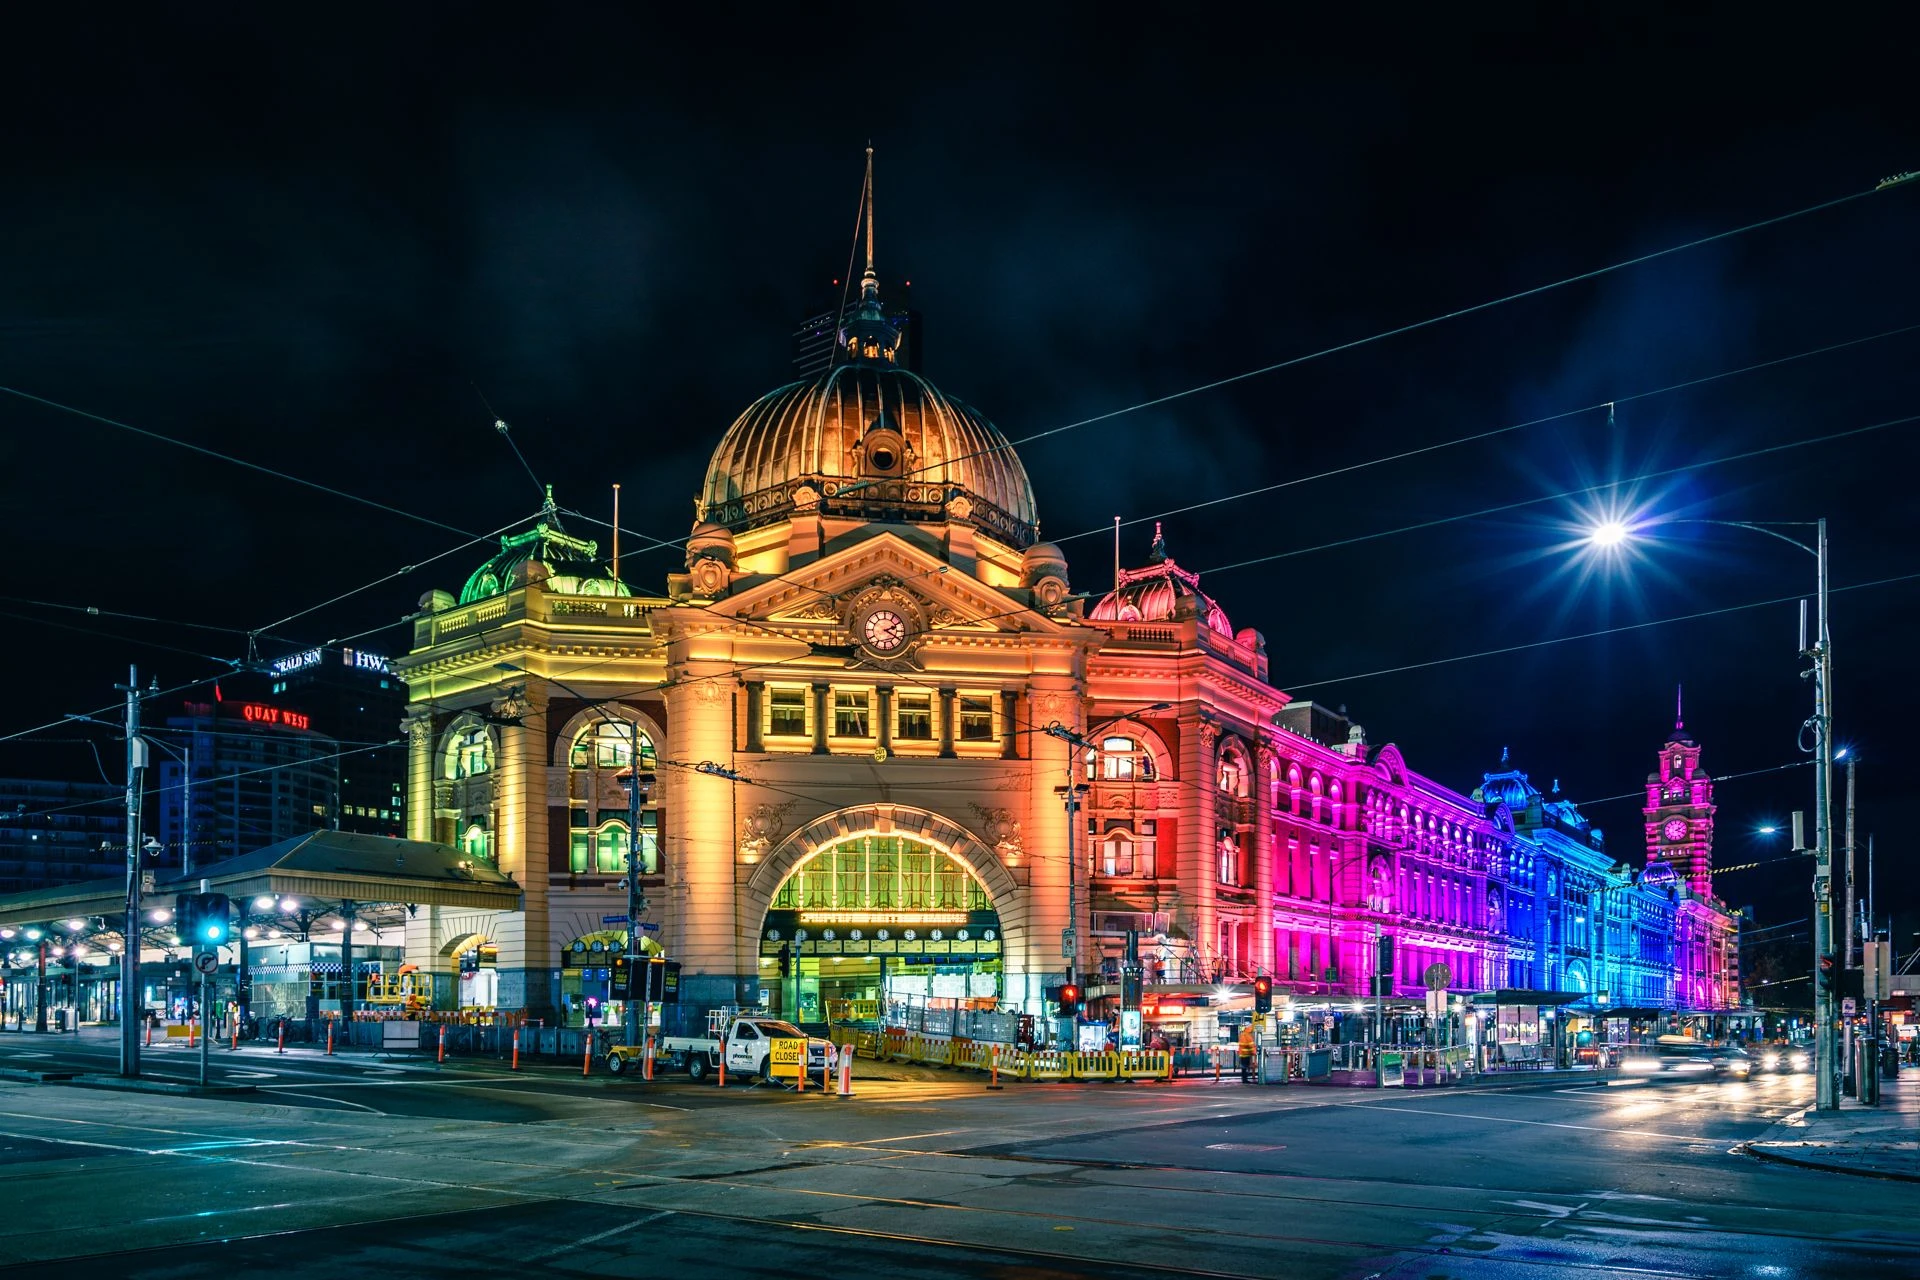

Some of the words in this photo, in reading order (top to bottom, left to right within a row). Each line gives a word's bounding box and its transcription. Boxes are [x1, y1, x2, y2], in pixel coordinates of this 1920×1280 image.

[303, 650, 322, 665] SUN
[244, 705, 279, 722] QUAY
[282, 711, 309, 729] WEST
[778, 1041, 799, 1049] ROAD
[775, 1052, 800, 1060] CLOSED
